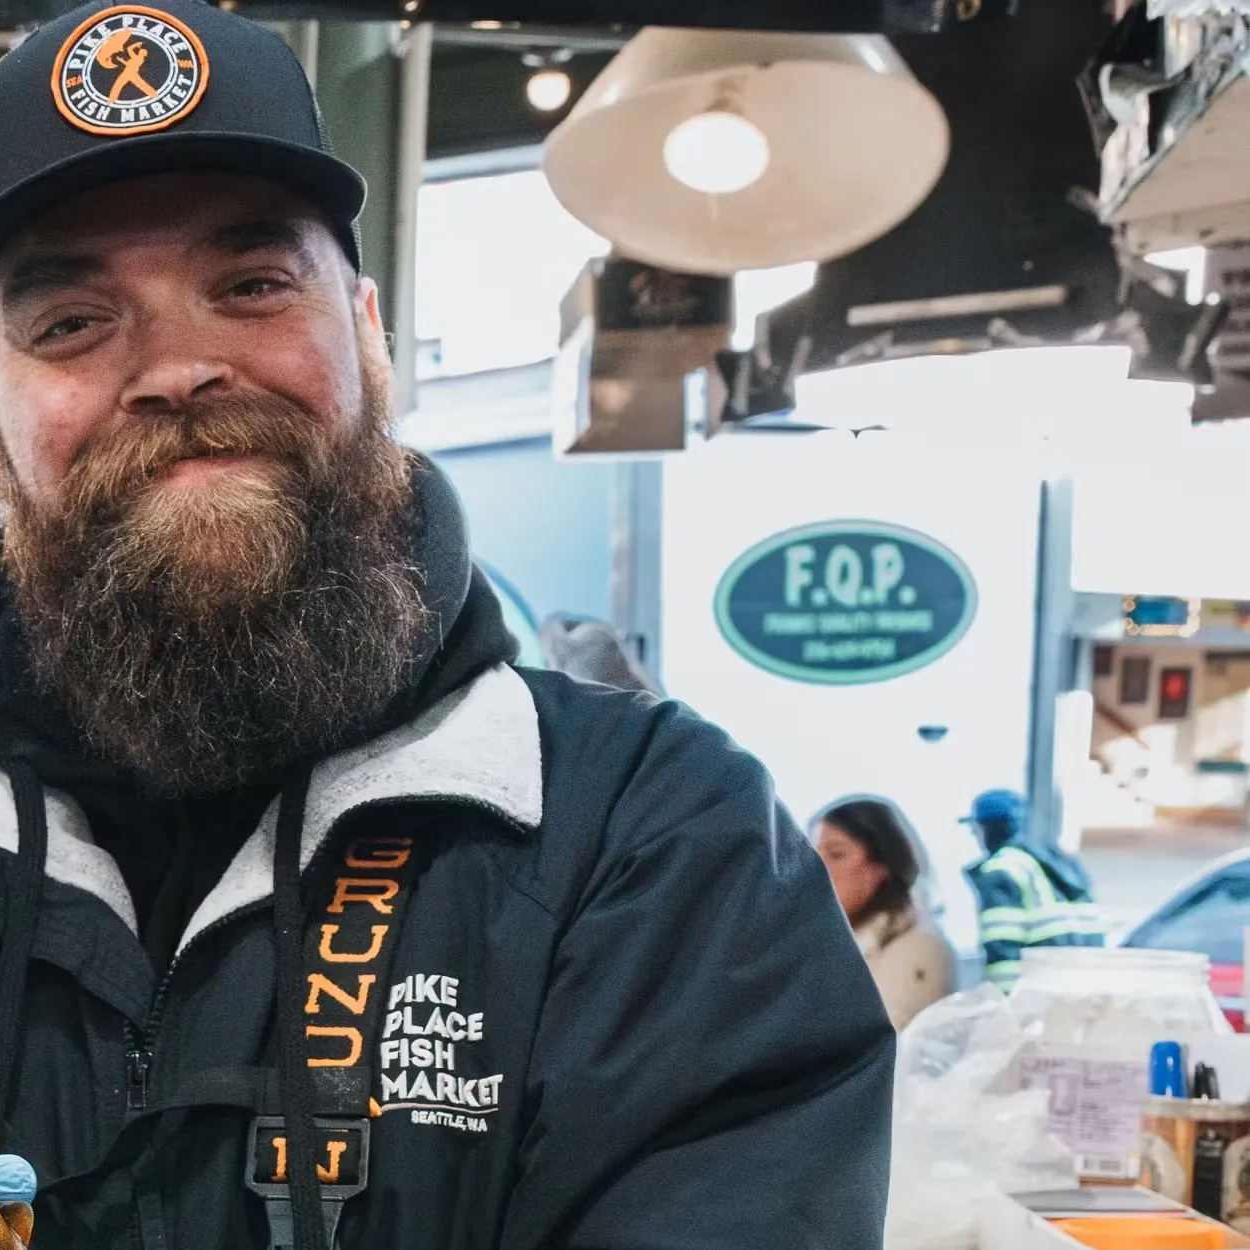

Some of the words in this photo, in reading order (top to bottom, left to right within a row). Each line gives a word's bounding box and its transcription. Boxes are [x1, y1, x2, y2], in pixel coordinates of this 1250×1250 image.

[68, 24, 111, 70] PIKE
[121, 16, 186, 54] PLACE
[70, 89, 111, 121] FISH
[120, 75, 193, 123] MARKET
[784, 543, 917, 607] F.Q.P.
[387, 973, 459, 1010] PIKE
[382, 1006, 484, 1041] PLACE
[381, 1039, 455, 1070] FISH
[381, 1070, 503, 1107] MARKET
